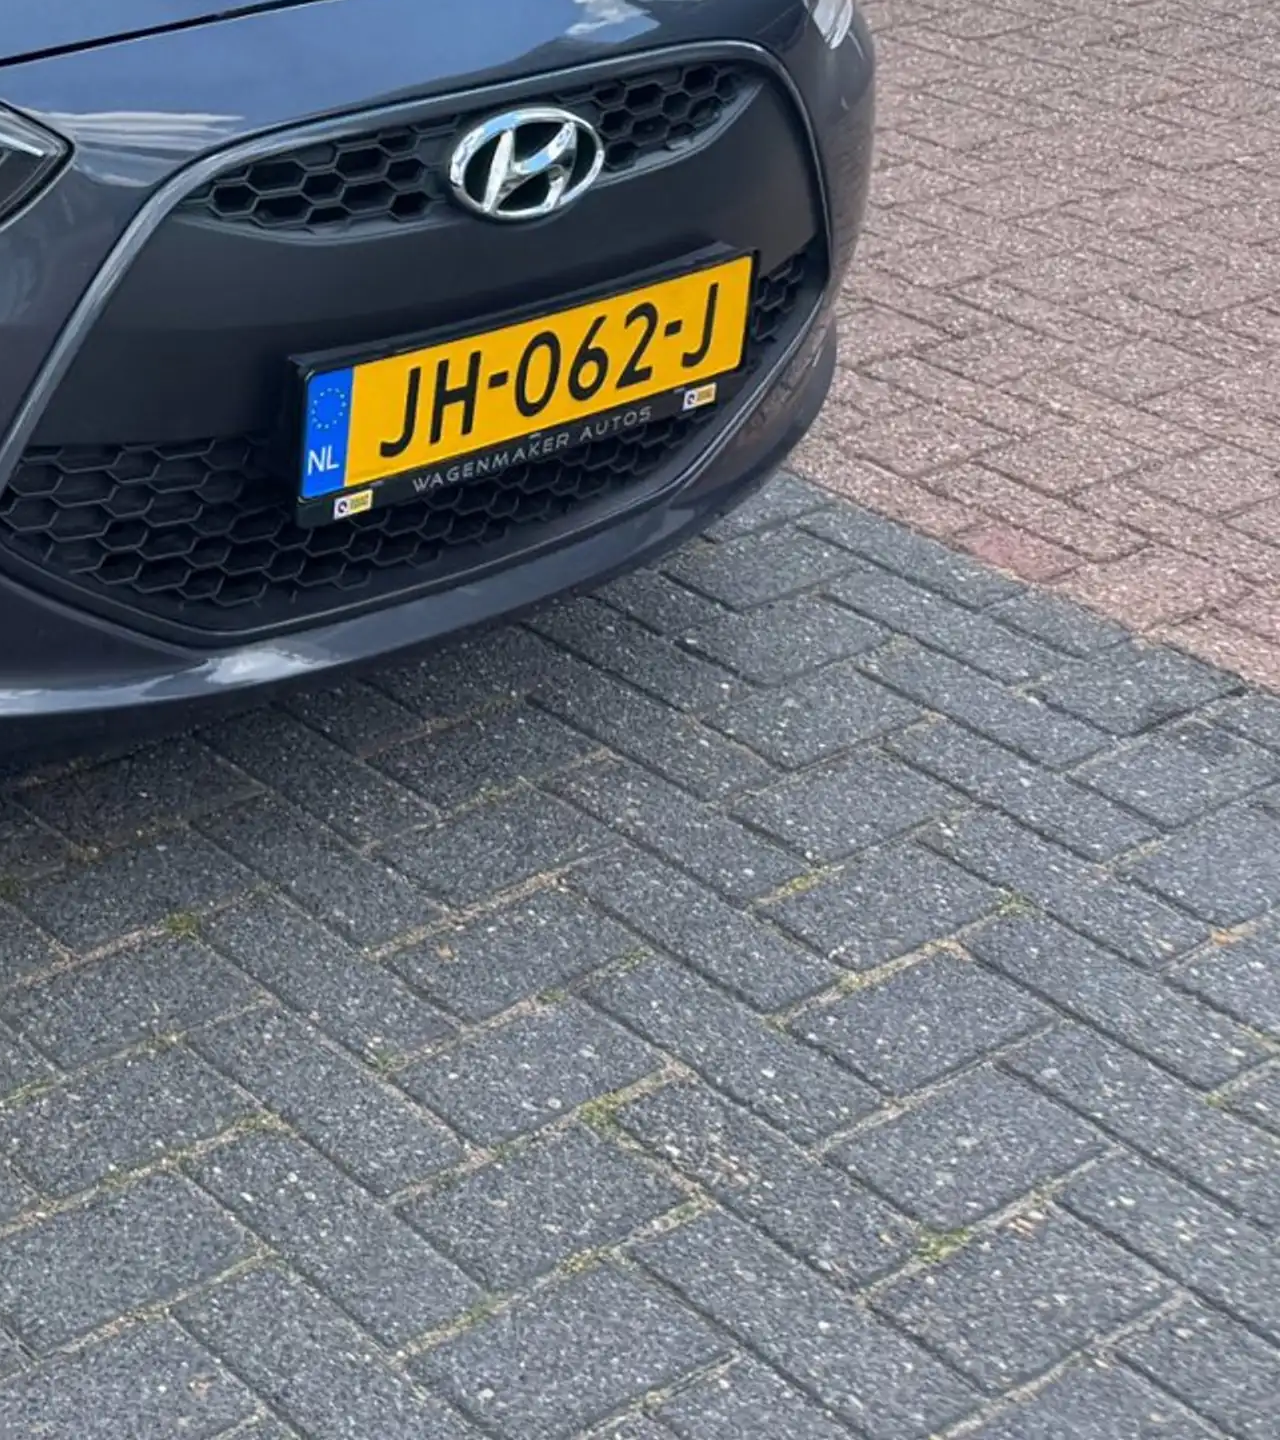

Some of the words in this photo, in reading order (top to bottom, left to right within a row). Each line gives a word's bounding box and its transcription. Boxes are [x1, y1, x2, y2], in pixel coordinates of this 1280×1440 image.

[380, 282, 720, 458] JH-062-J
[307, 445, 340, 475] NL
[412, 432, 570, 494] WAGENMAKER
